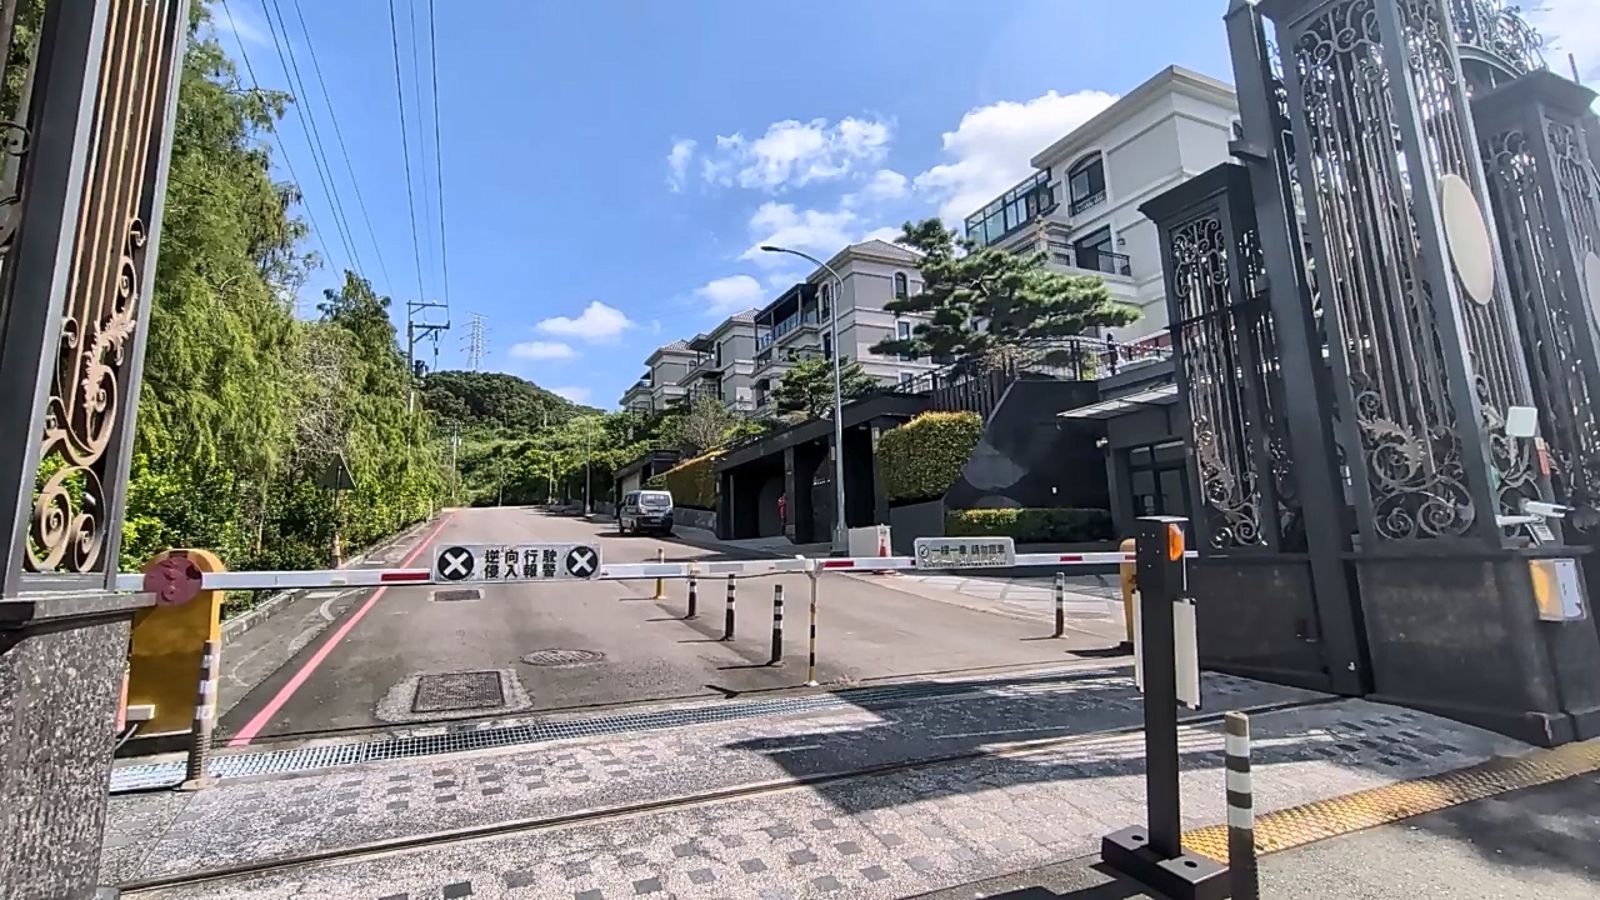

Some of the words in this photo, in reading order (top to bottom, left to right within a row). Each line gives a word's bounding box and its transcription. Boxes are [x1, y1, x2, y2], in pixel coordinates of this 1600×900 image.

[484, 549, 557, 564] 逆向行駛
[484, 564, 557, 579] 侵入報警
